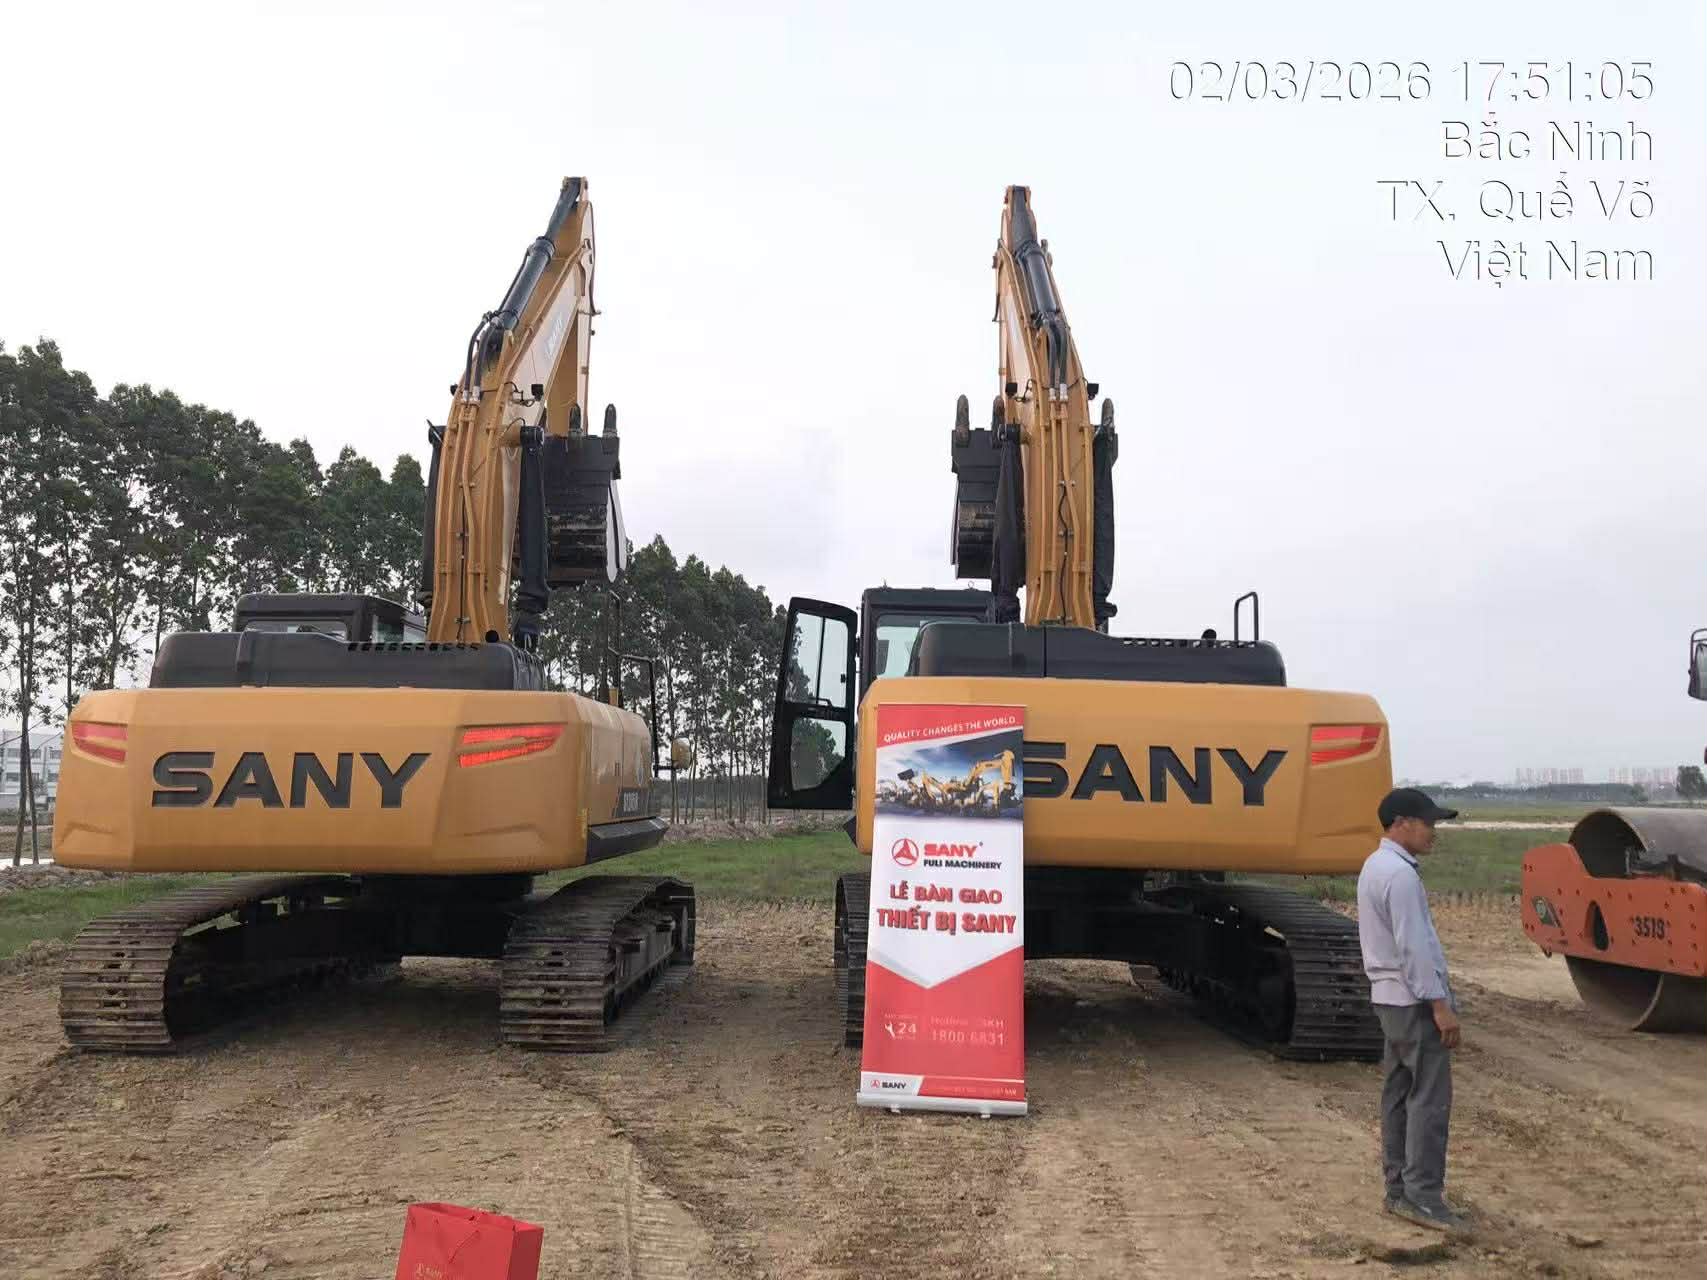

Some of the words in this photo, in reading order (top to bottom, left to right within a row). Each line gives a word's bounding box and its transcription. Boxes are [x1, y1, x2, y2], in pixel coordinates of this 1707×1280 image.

[883, 728, 921, 743] QUALITY
[922, 723, 964, 737] CHANGES
[965, 720, 983, 731] THE
[983, 716, 1017, 728] WORLD
[151, 751, 432, 809] SANY
[1023, 740, 1288, 807] SANY
[923, 842, 978, 859] SANY
[923, 859, 943, 869] FULI
[944, 859, 1003, 870] MACHINERY
[890, 880, 909, 900] LỄ
[914, 883, 954, 903] BÀN
[958, 887, 1003, 905] GIAO
[877, 904, 931, 931] THIẾT
[935, 911, 957, 935] BỊ
[961, 912, 1017, 934] SANY
[881, 1080, 907, 1090] SANY
